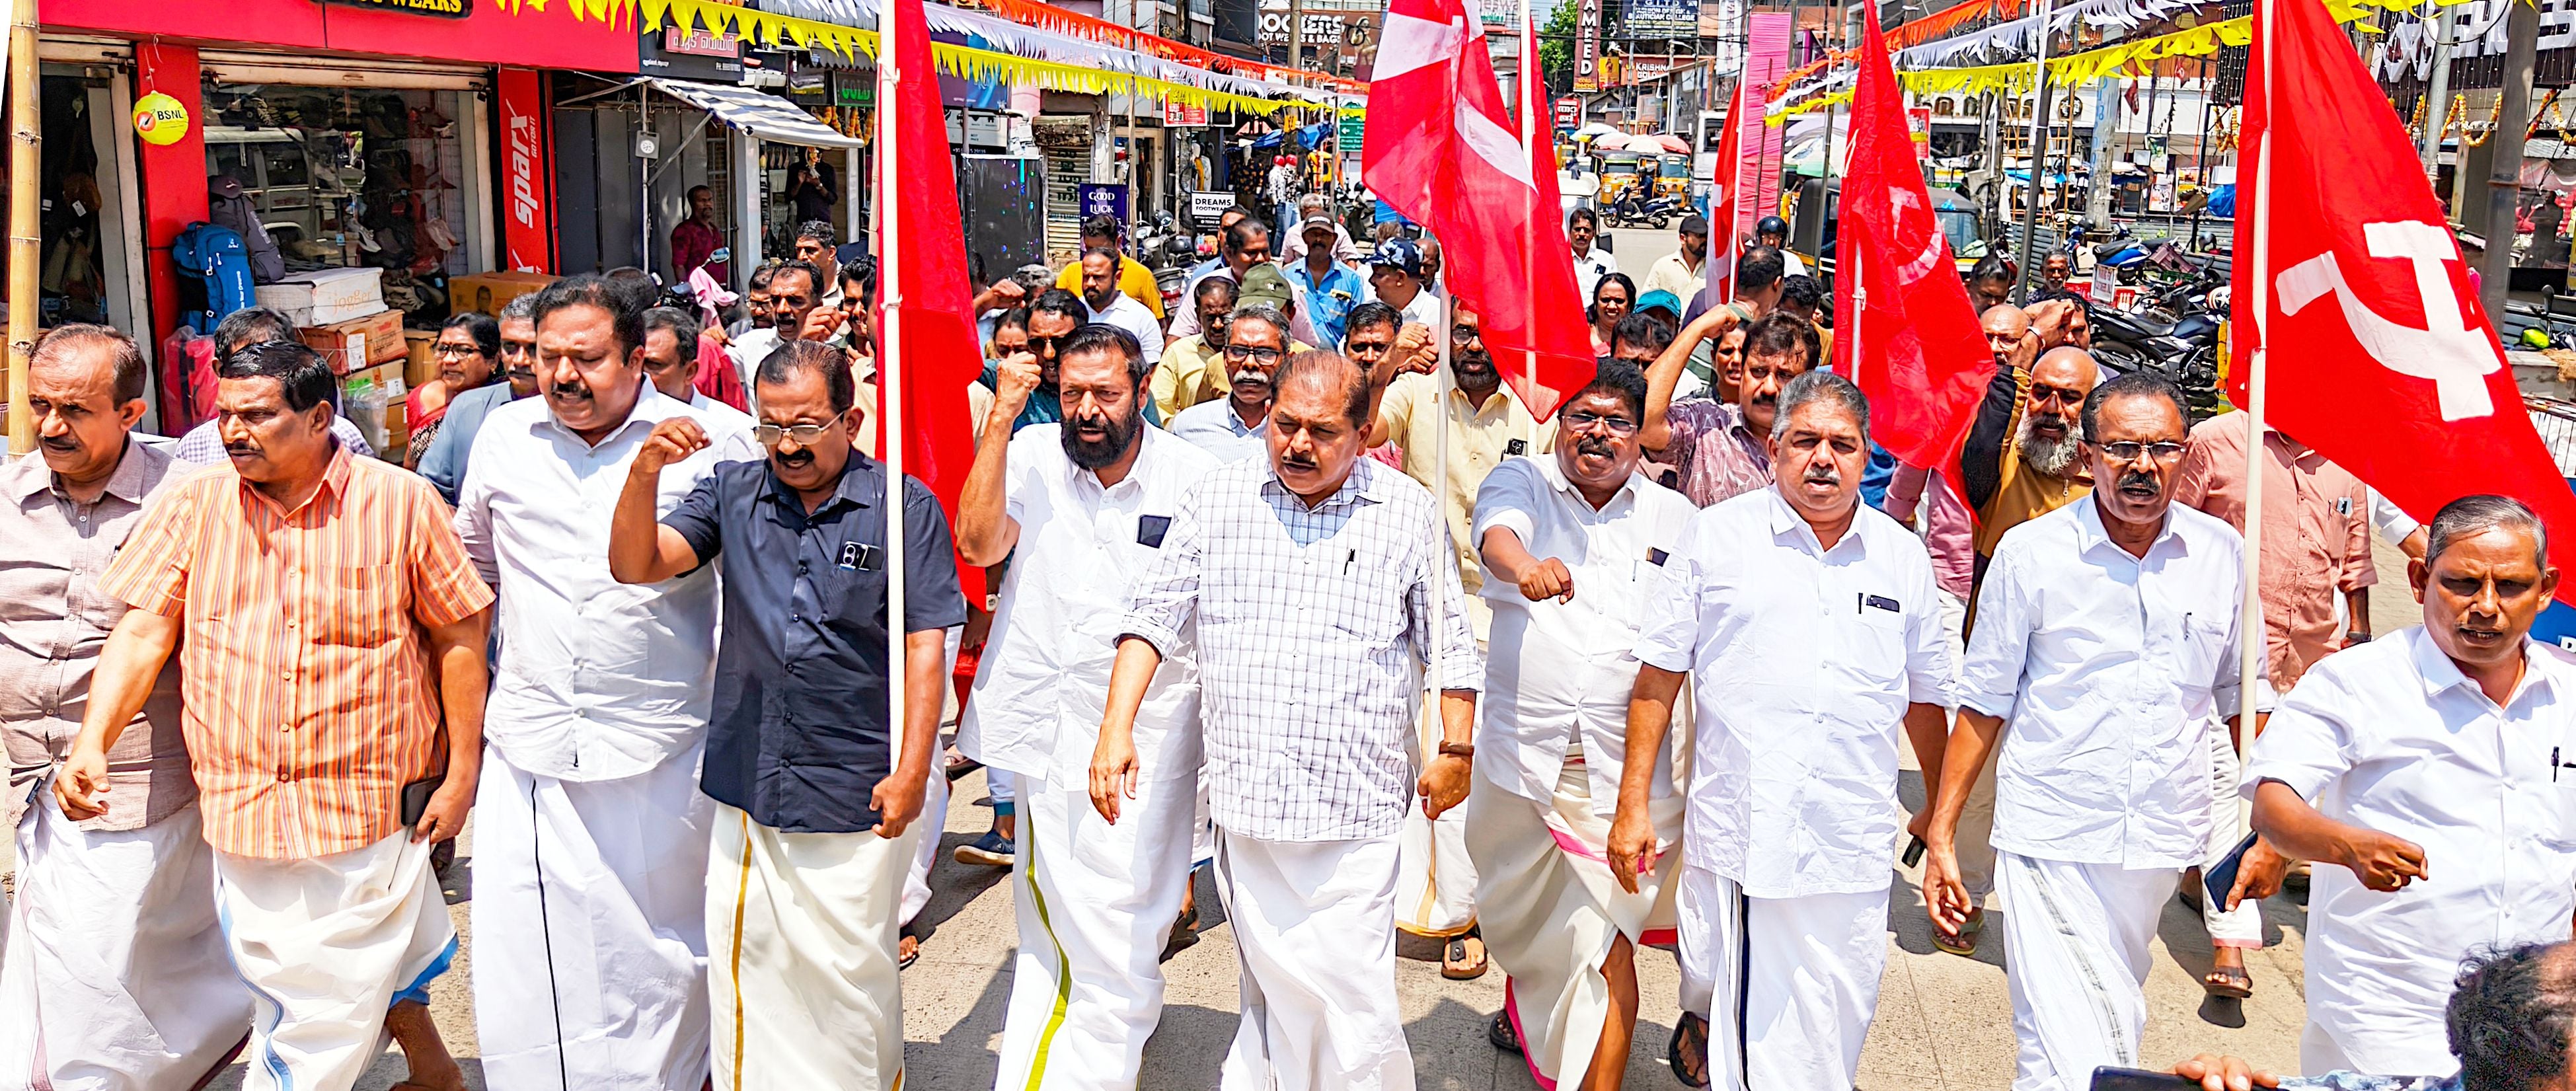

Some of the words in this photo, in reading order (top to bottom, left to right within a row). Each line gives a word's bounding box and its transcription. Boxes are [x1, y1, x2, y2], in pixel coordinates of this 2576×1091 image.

[1308, 34, 1314, 44] &
[157, 110, 184, 120] BSNL
[529, 115, 536, 126] IT
[531, 143, 537, 159] GO
[1088, 192, 1115, 202] GOOD
[1090, 204, 1114, 214] LUCK
